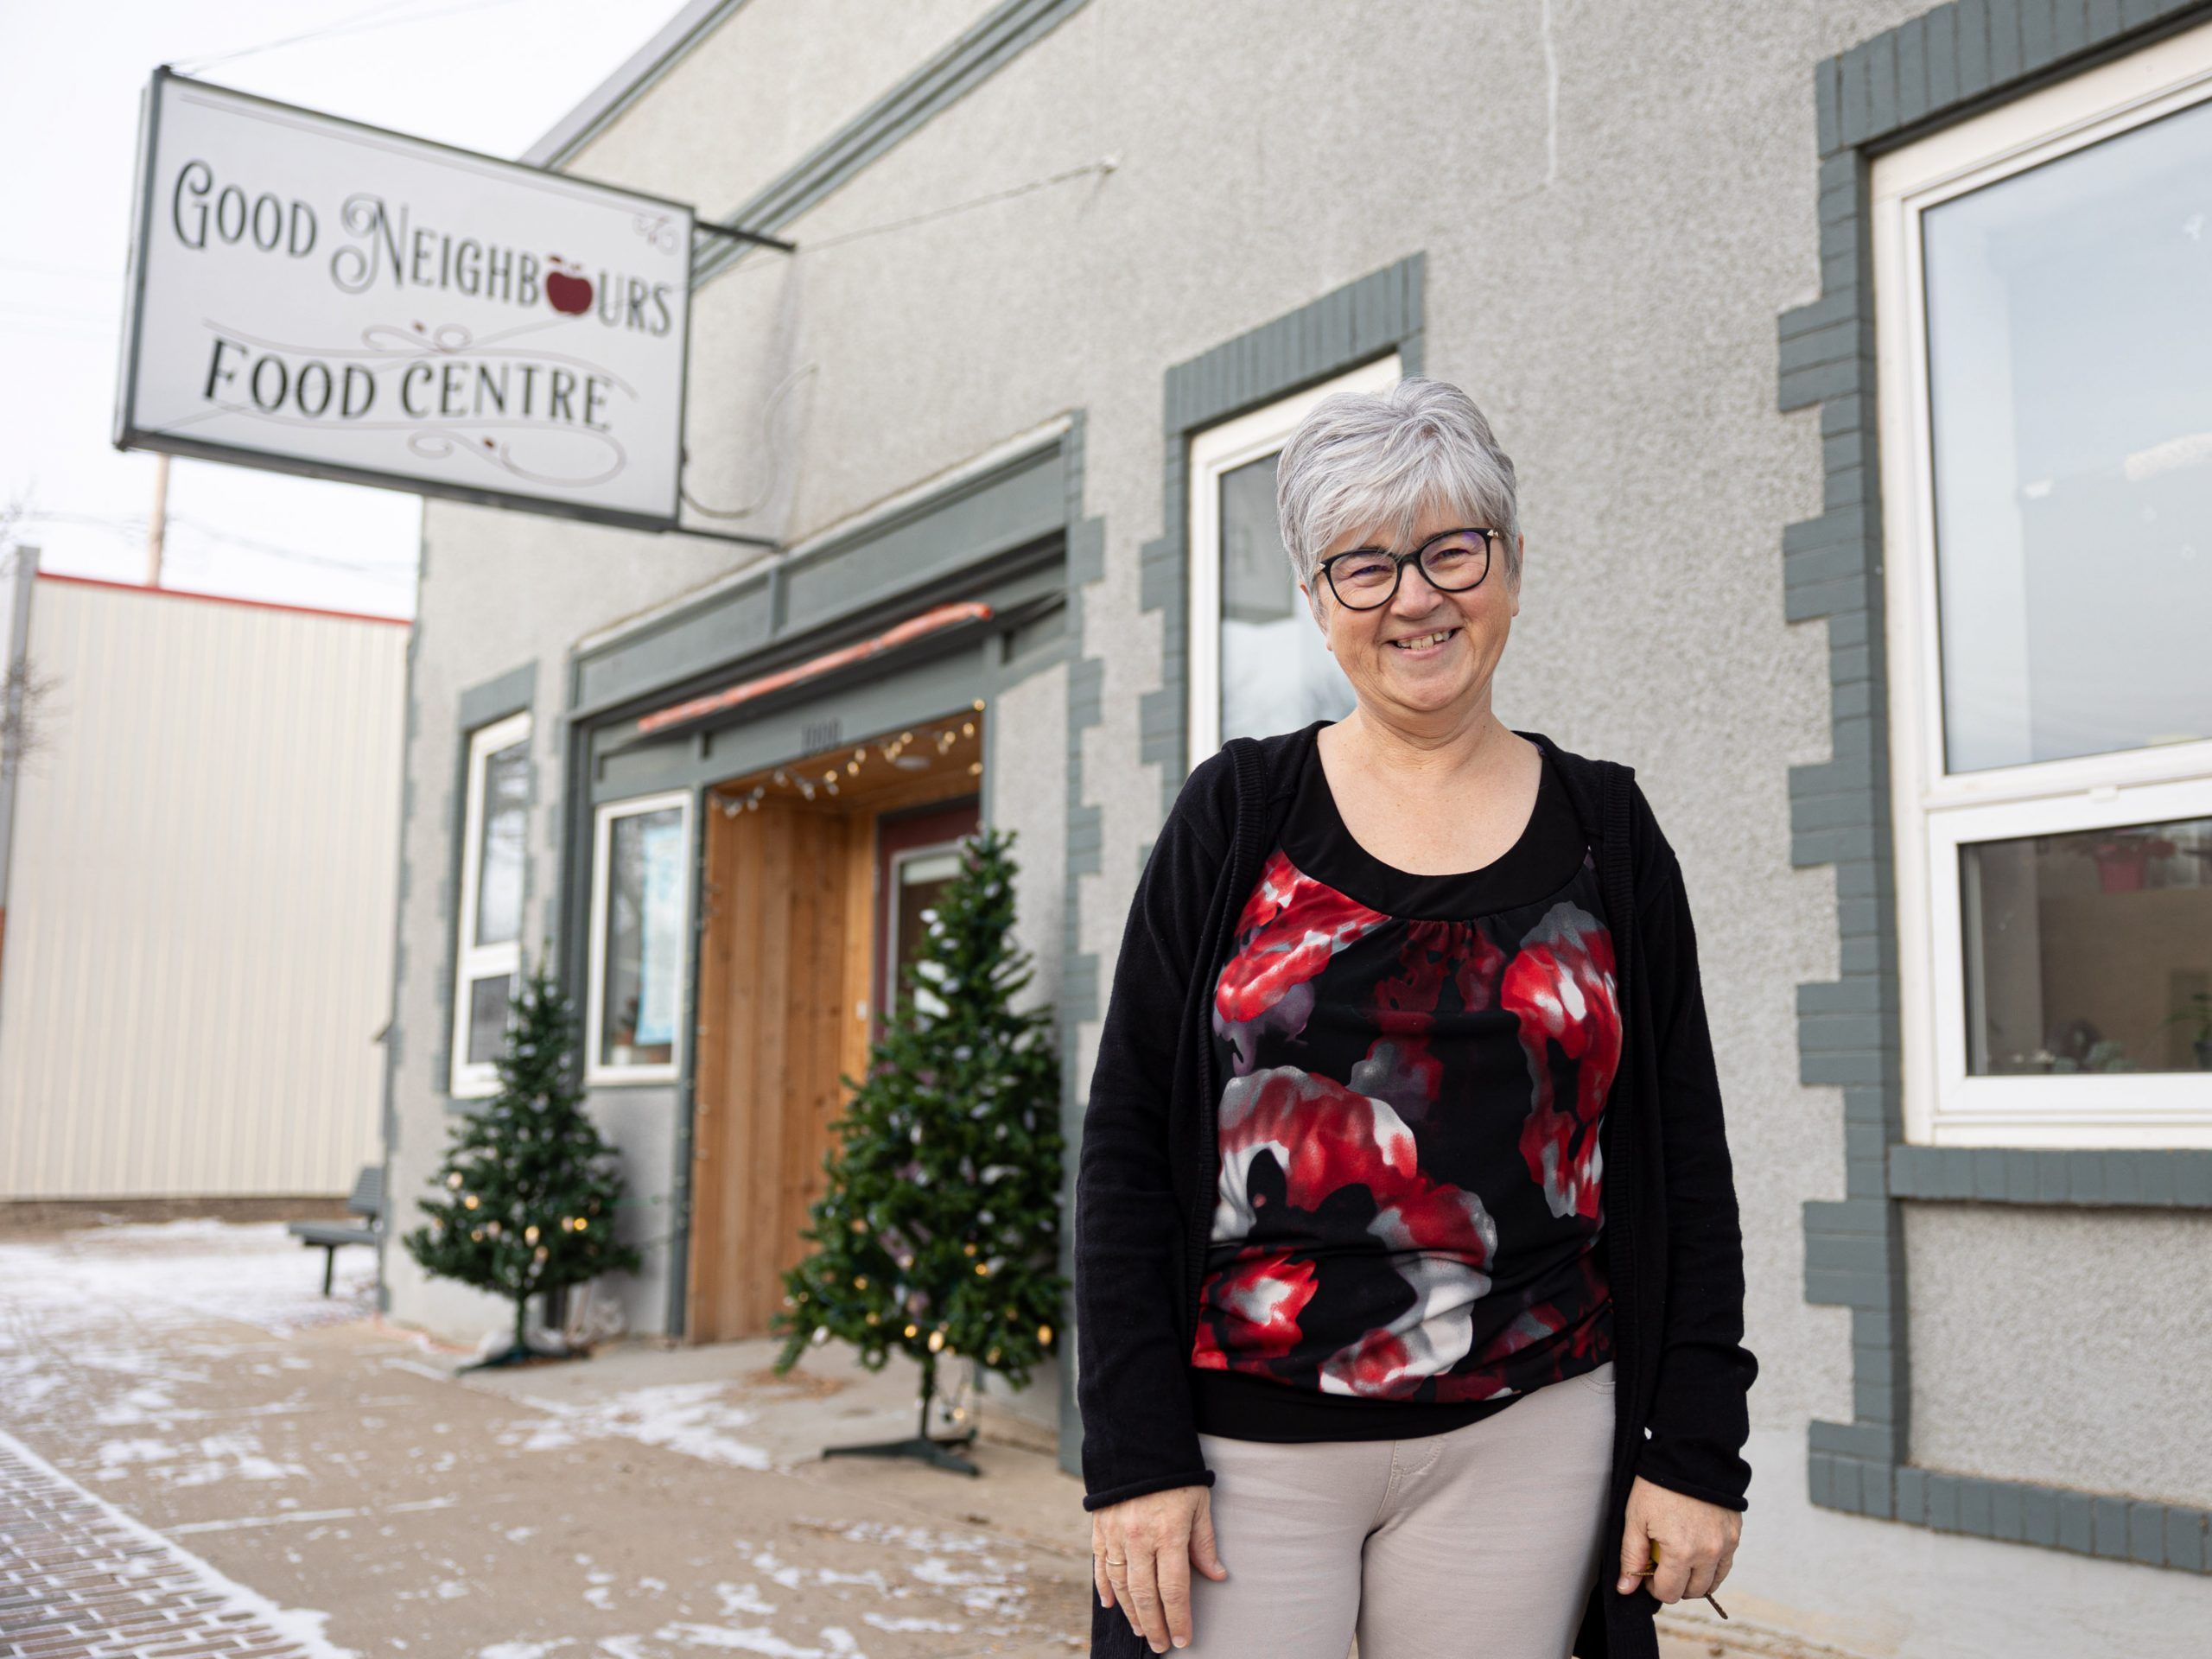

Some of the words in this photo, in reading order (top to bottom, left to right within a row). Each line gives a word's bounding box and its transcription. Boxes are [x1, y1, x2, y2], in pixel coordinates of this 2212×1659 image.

[173, 159, 318, 258] GOOD
[204, 338, 376, 419] FOOD
[401, 360, 612, 429] CENTRE
